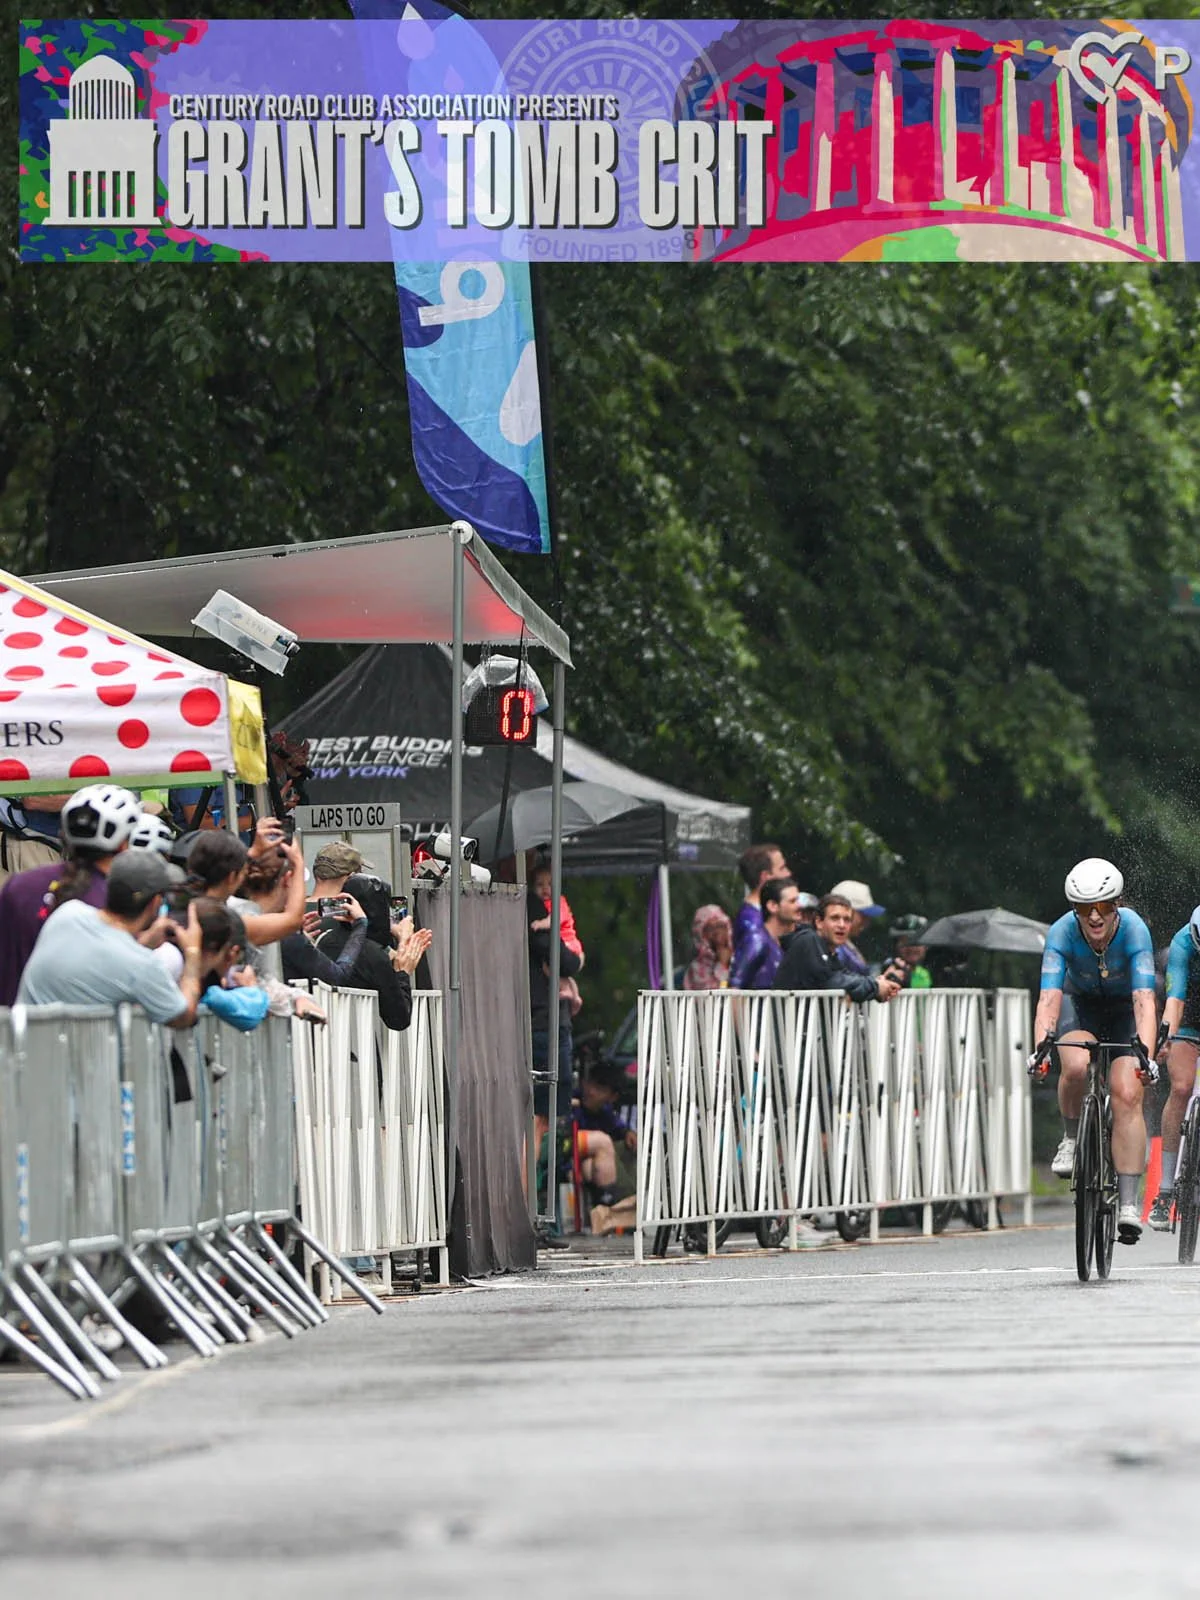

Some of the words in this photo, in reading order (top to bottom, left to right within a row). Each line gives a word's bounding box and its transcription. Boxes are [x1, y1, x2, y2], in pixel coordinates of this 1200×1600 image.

[501, 689, 532, 740] 0
[307, 752, 448, 769] HALLENGE.
[348, 766, 412, 780] YORK
[311, 808, 343, 828] LAPS
[346, 807, 363, 827] TO
[366, 806, 385, 826] GO
